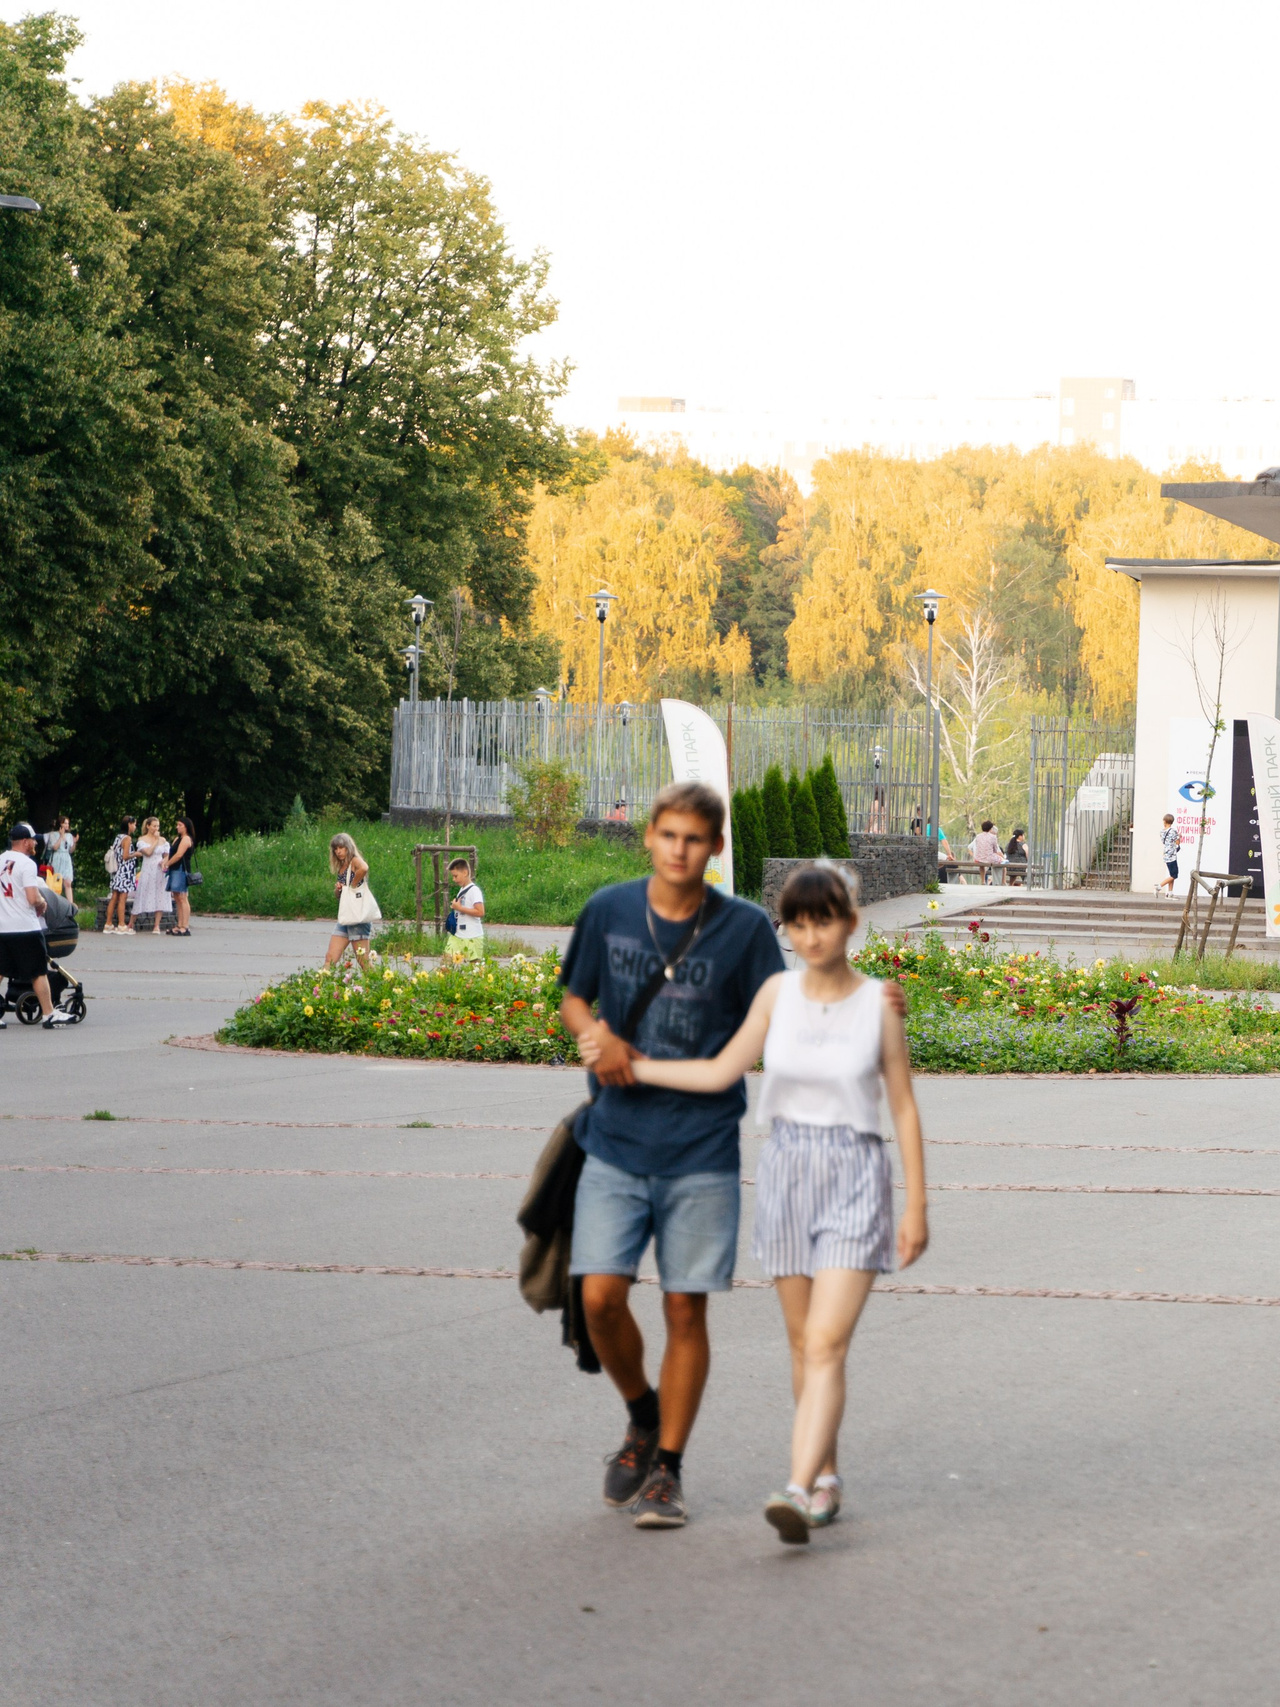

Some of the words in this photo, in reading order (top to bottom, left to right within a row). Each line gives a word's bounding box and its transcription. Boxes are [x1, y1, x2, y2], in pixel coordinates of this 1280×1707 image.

[681, 721, 699, 762] ПАРК
[1263, 735, 1280, 779] ПАРК
[1176, 816, 1216, 825] ФЕСТИЛЬ
[1176, 826, 1211, 835] УЛИЧНОО
[1179, 835, 1195, 844] ИНО
[610, 945, 708, 986] CHICGO
